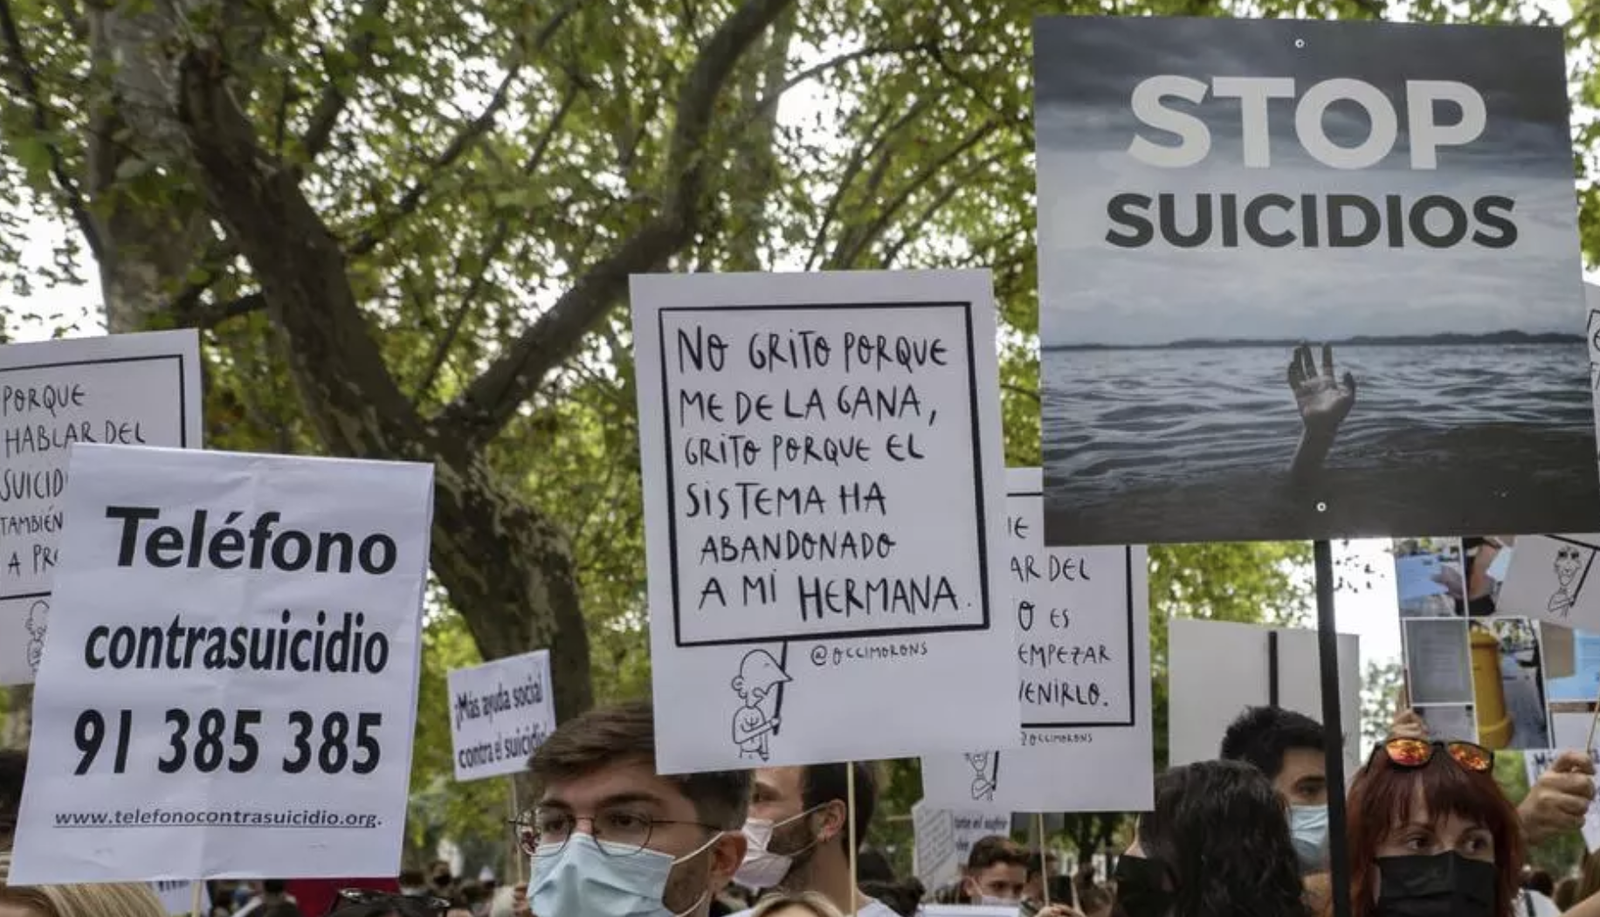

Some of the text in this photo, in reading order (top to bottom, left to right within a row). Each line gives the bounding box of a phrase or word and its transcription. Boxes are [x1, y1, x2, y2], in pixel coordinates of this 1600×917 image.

[1124, 73, 1488, 171] STOP
[1104, 192, 1520, 249] SUICIDIOS
[677, 325, 947, 374] NO GRITO PORQUE
[3, 384, 85, 418] PORQUE
[679, 384, 937, 426] ME DE LA GANA,
[5, 420, 146, 458] HABLAR DEL
[684, 433, 924, 470] GRITO PORQUE EL
[686, 481, 886, 520] SISTEMA HA
[0, 504, 64, 536] TAMBIÉN
[105, 505, 398, 575] Teléfono
[701, 529, 896, 563] ABANDONADO
[7, 552, 21, 575] A
[1049, 554, 1091, 582] DEL
[698, 577, 727, 609] A
[797, 574, 974, 622] HERMANA.
[1049, 608, 1069, 629] ES
[84, 608, 389, 674] contrasuicidio
[810, 642, 928, 667] @OCCIMORONS
[1018, 643, 1111, 669] EMPEZAR
[482, 681, 511, 725] ayuda
[512, 674, 544, 708] social
[74, 707, 382, 776] 91 385 385
[458, 743, 493, 769] contra
[54, 807, 383, 828] www.telefonocontrasuicidio.org.
